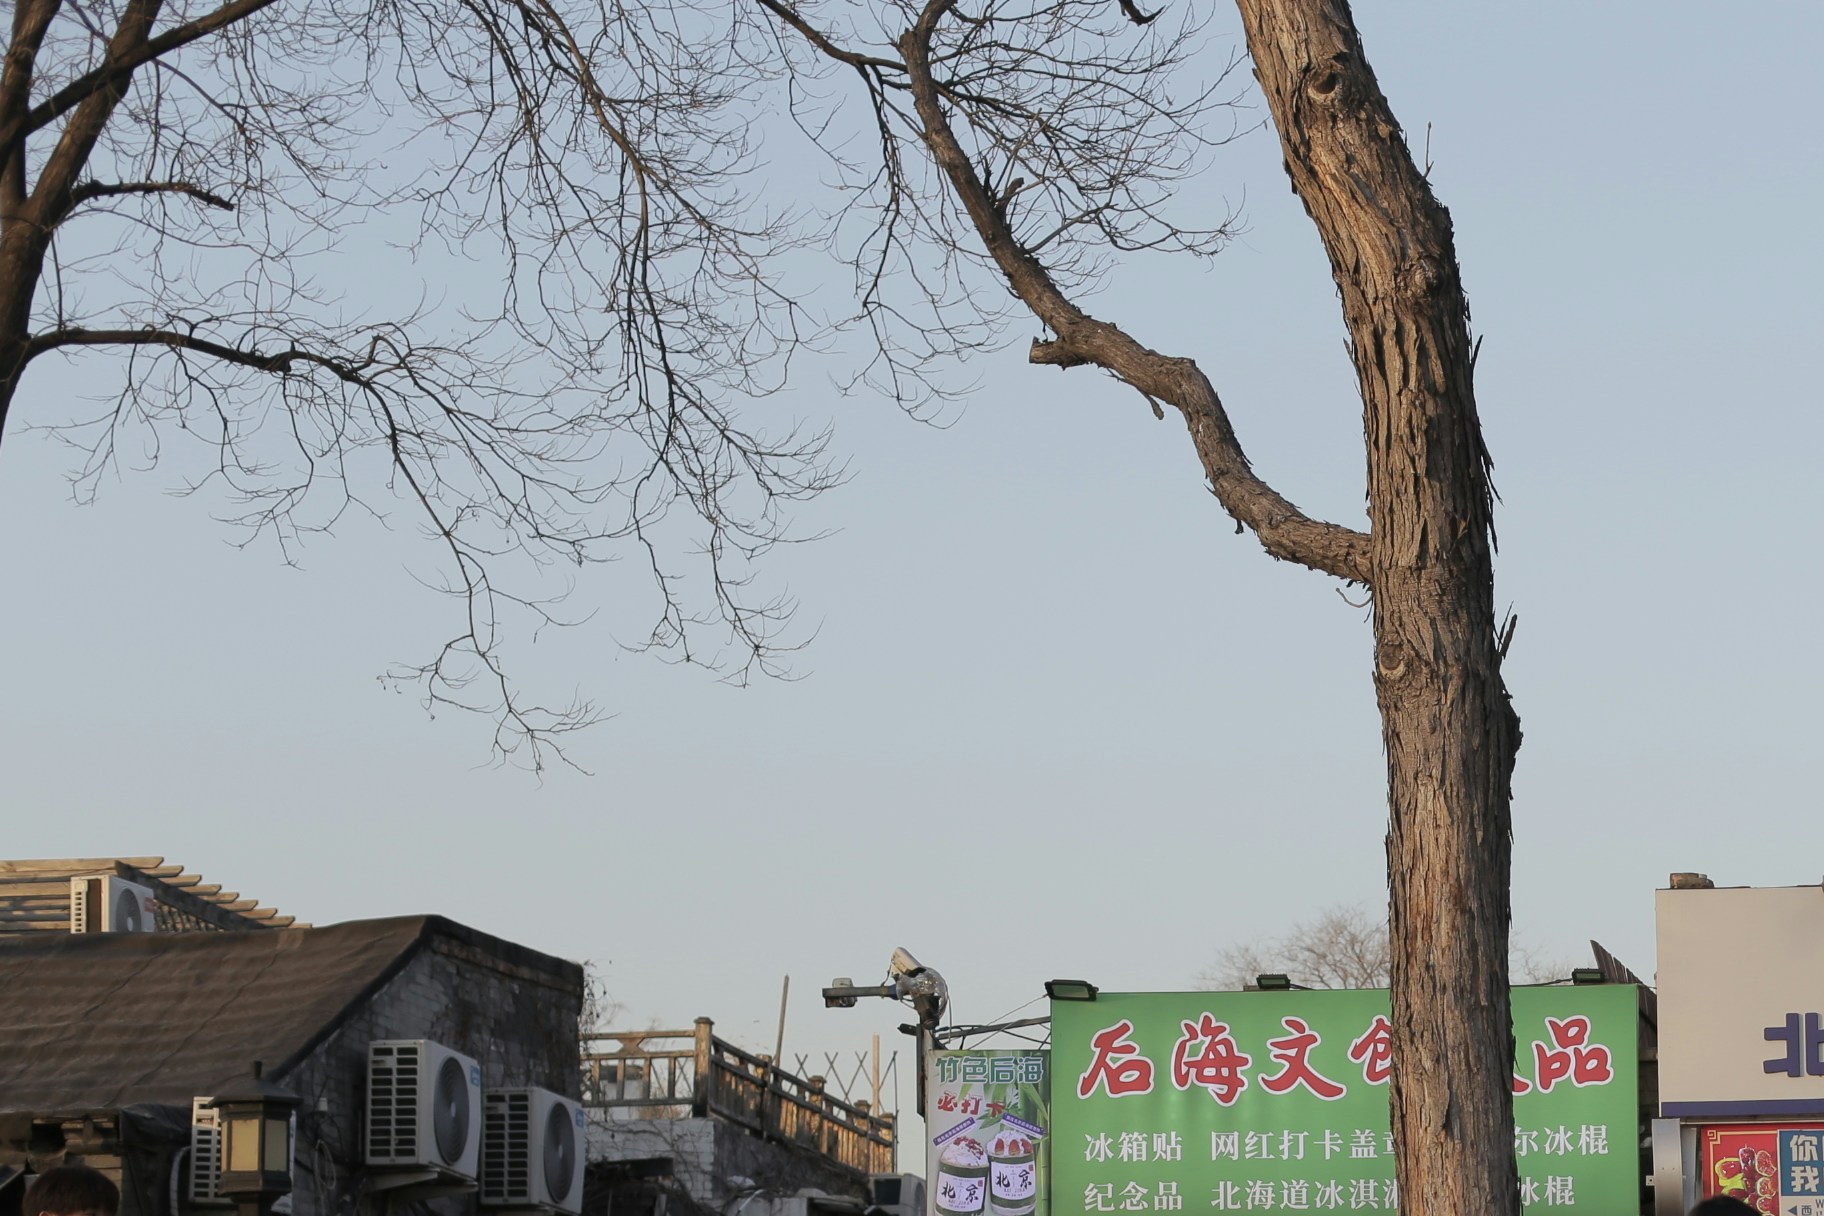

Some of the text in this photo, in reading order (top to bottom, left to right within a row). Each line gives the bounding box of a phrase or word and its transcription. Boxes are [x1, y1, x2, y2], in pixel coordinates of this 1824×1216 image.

[935, 1055, 1044, 1084] 竹色后海
[1083, 1130, 1184, 1163] 冰箱贴
[1083, 1180, 1184, 1213] 纪念品
[1801, 1205, 1812, 1215] 西
